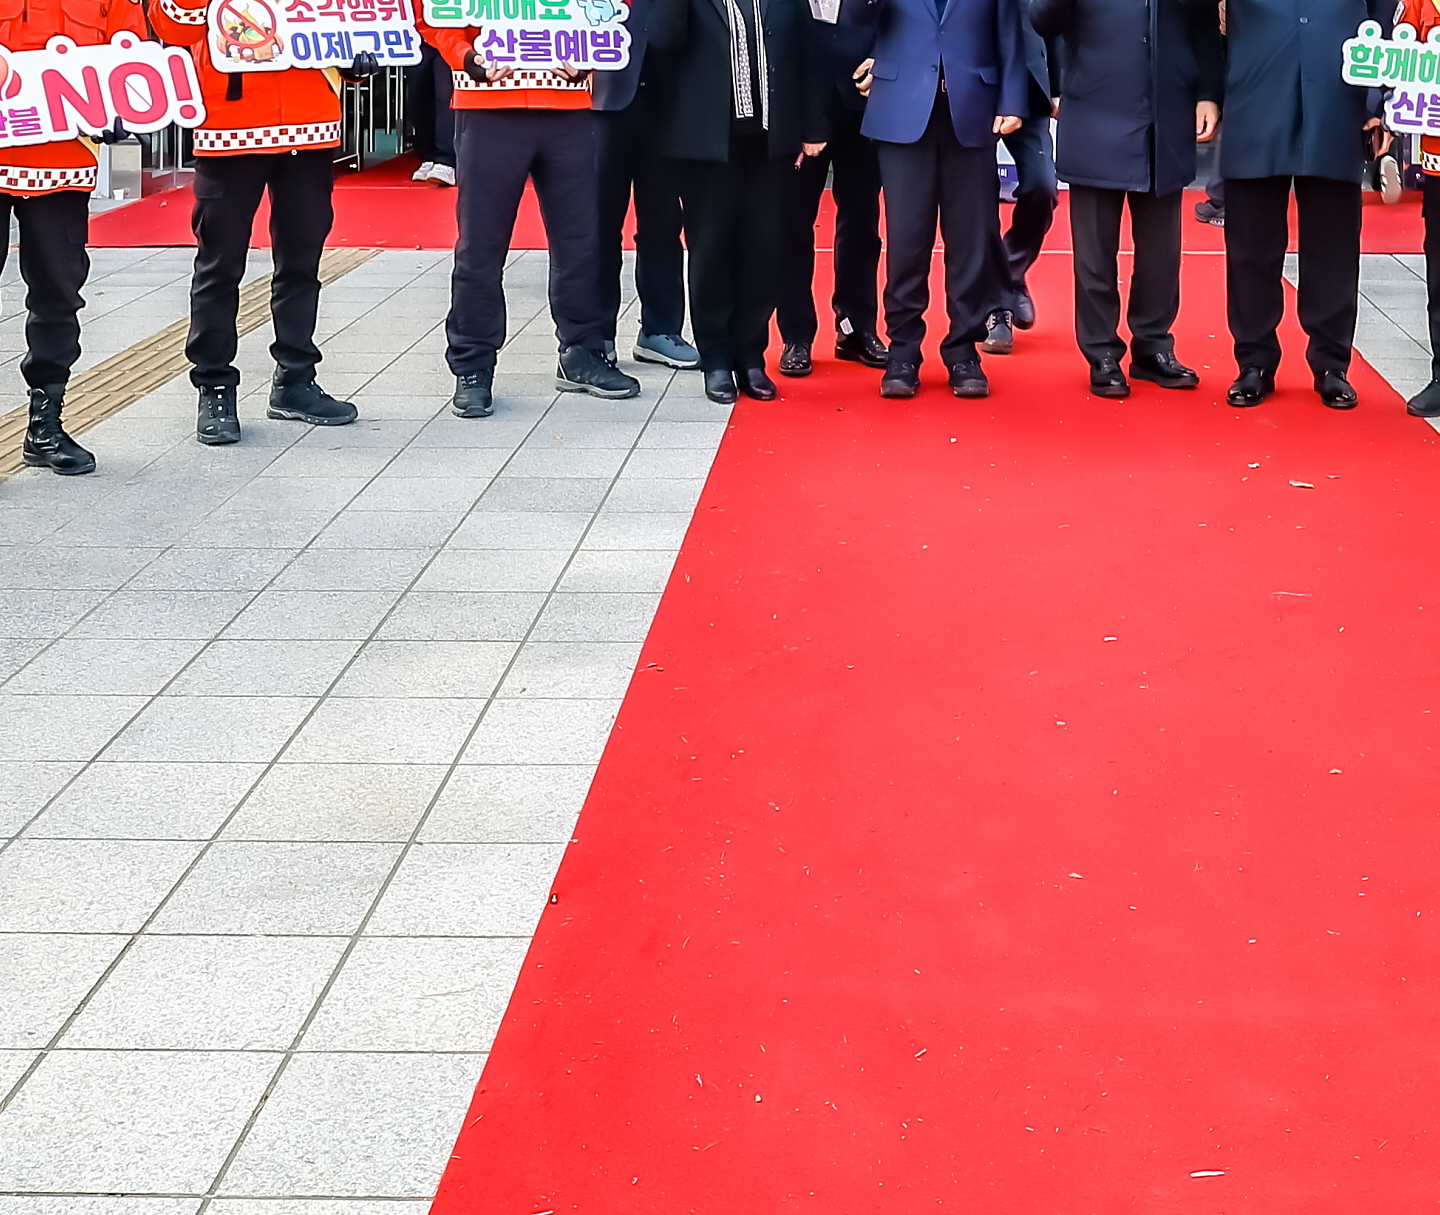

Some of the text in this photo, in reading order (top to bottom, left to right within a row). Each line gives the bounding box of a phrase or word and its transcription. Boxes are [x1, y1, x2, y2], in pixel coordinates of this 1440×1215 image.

[290, 29, 415, 61] 이제그만
[482, 29, 625, 63] 산불예방
[41, 45, 200, 133] NO!
